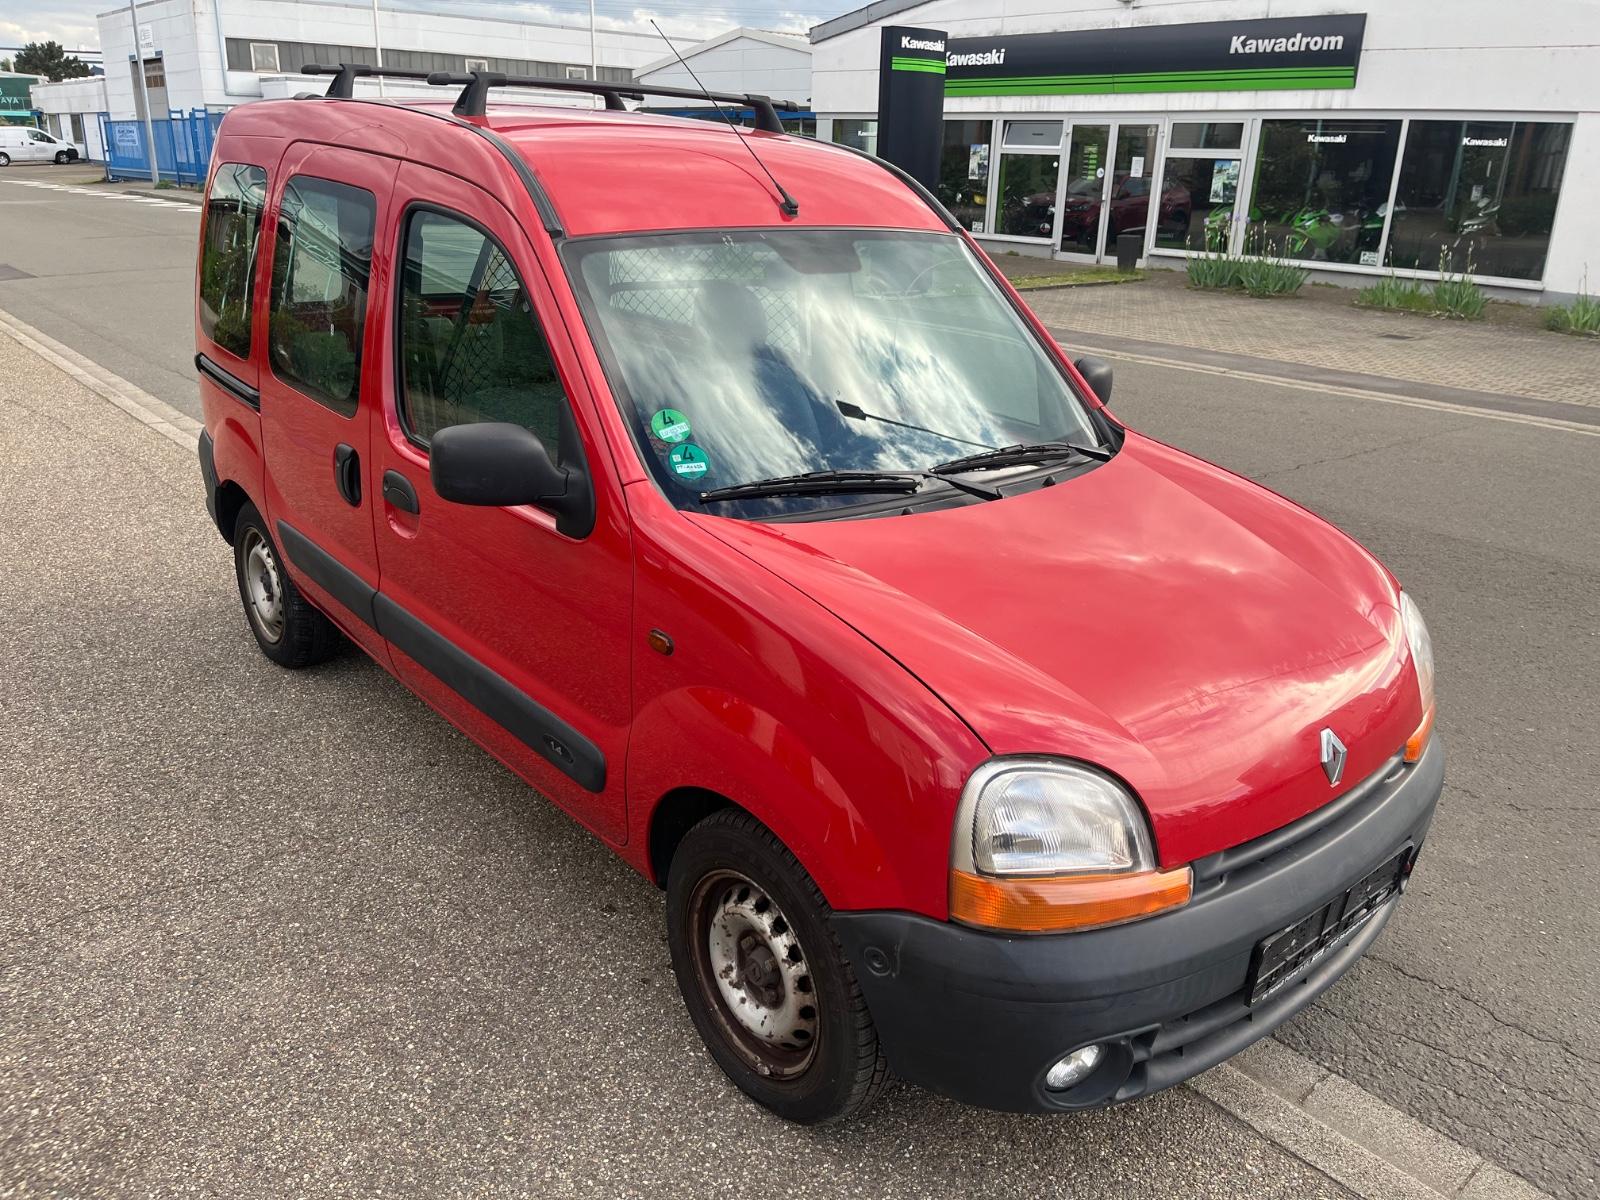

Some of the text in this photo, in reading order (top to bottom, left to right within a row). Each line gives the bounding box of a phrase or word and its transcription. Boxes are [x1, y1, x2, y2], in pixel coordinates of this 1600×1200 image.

[901, 35, 945, 52] Kawasaki
[1229, 32, 1344, 54] Kawadrom
[1307, 134, 1348, 143] Kawasaki
[1462, 136, 1508, 147] Kawasaki
[662, 410, 674, 425] 4
[683, 446, 695, 461] 4
